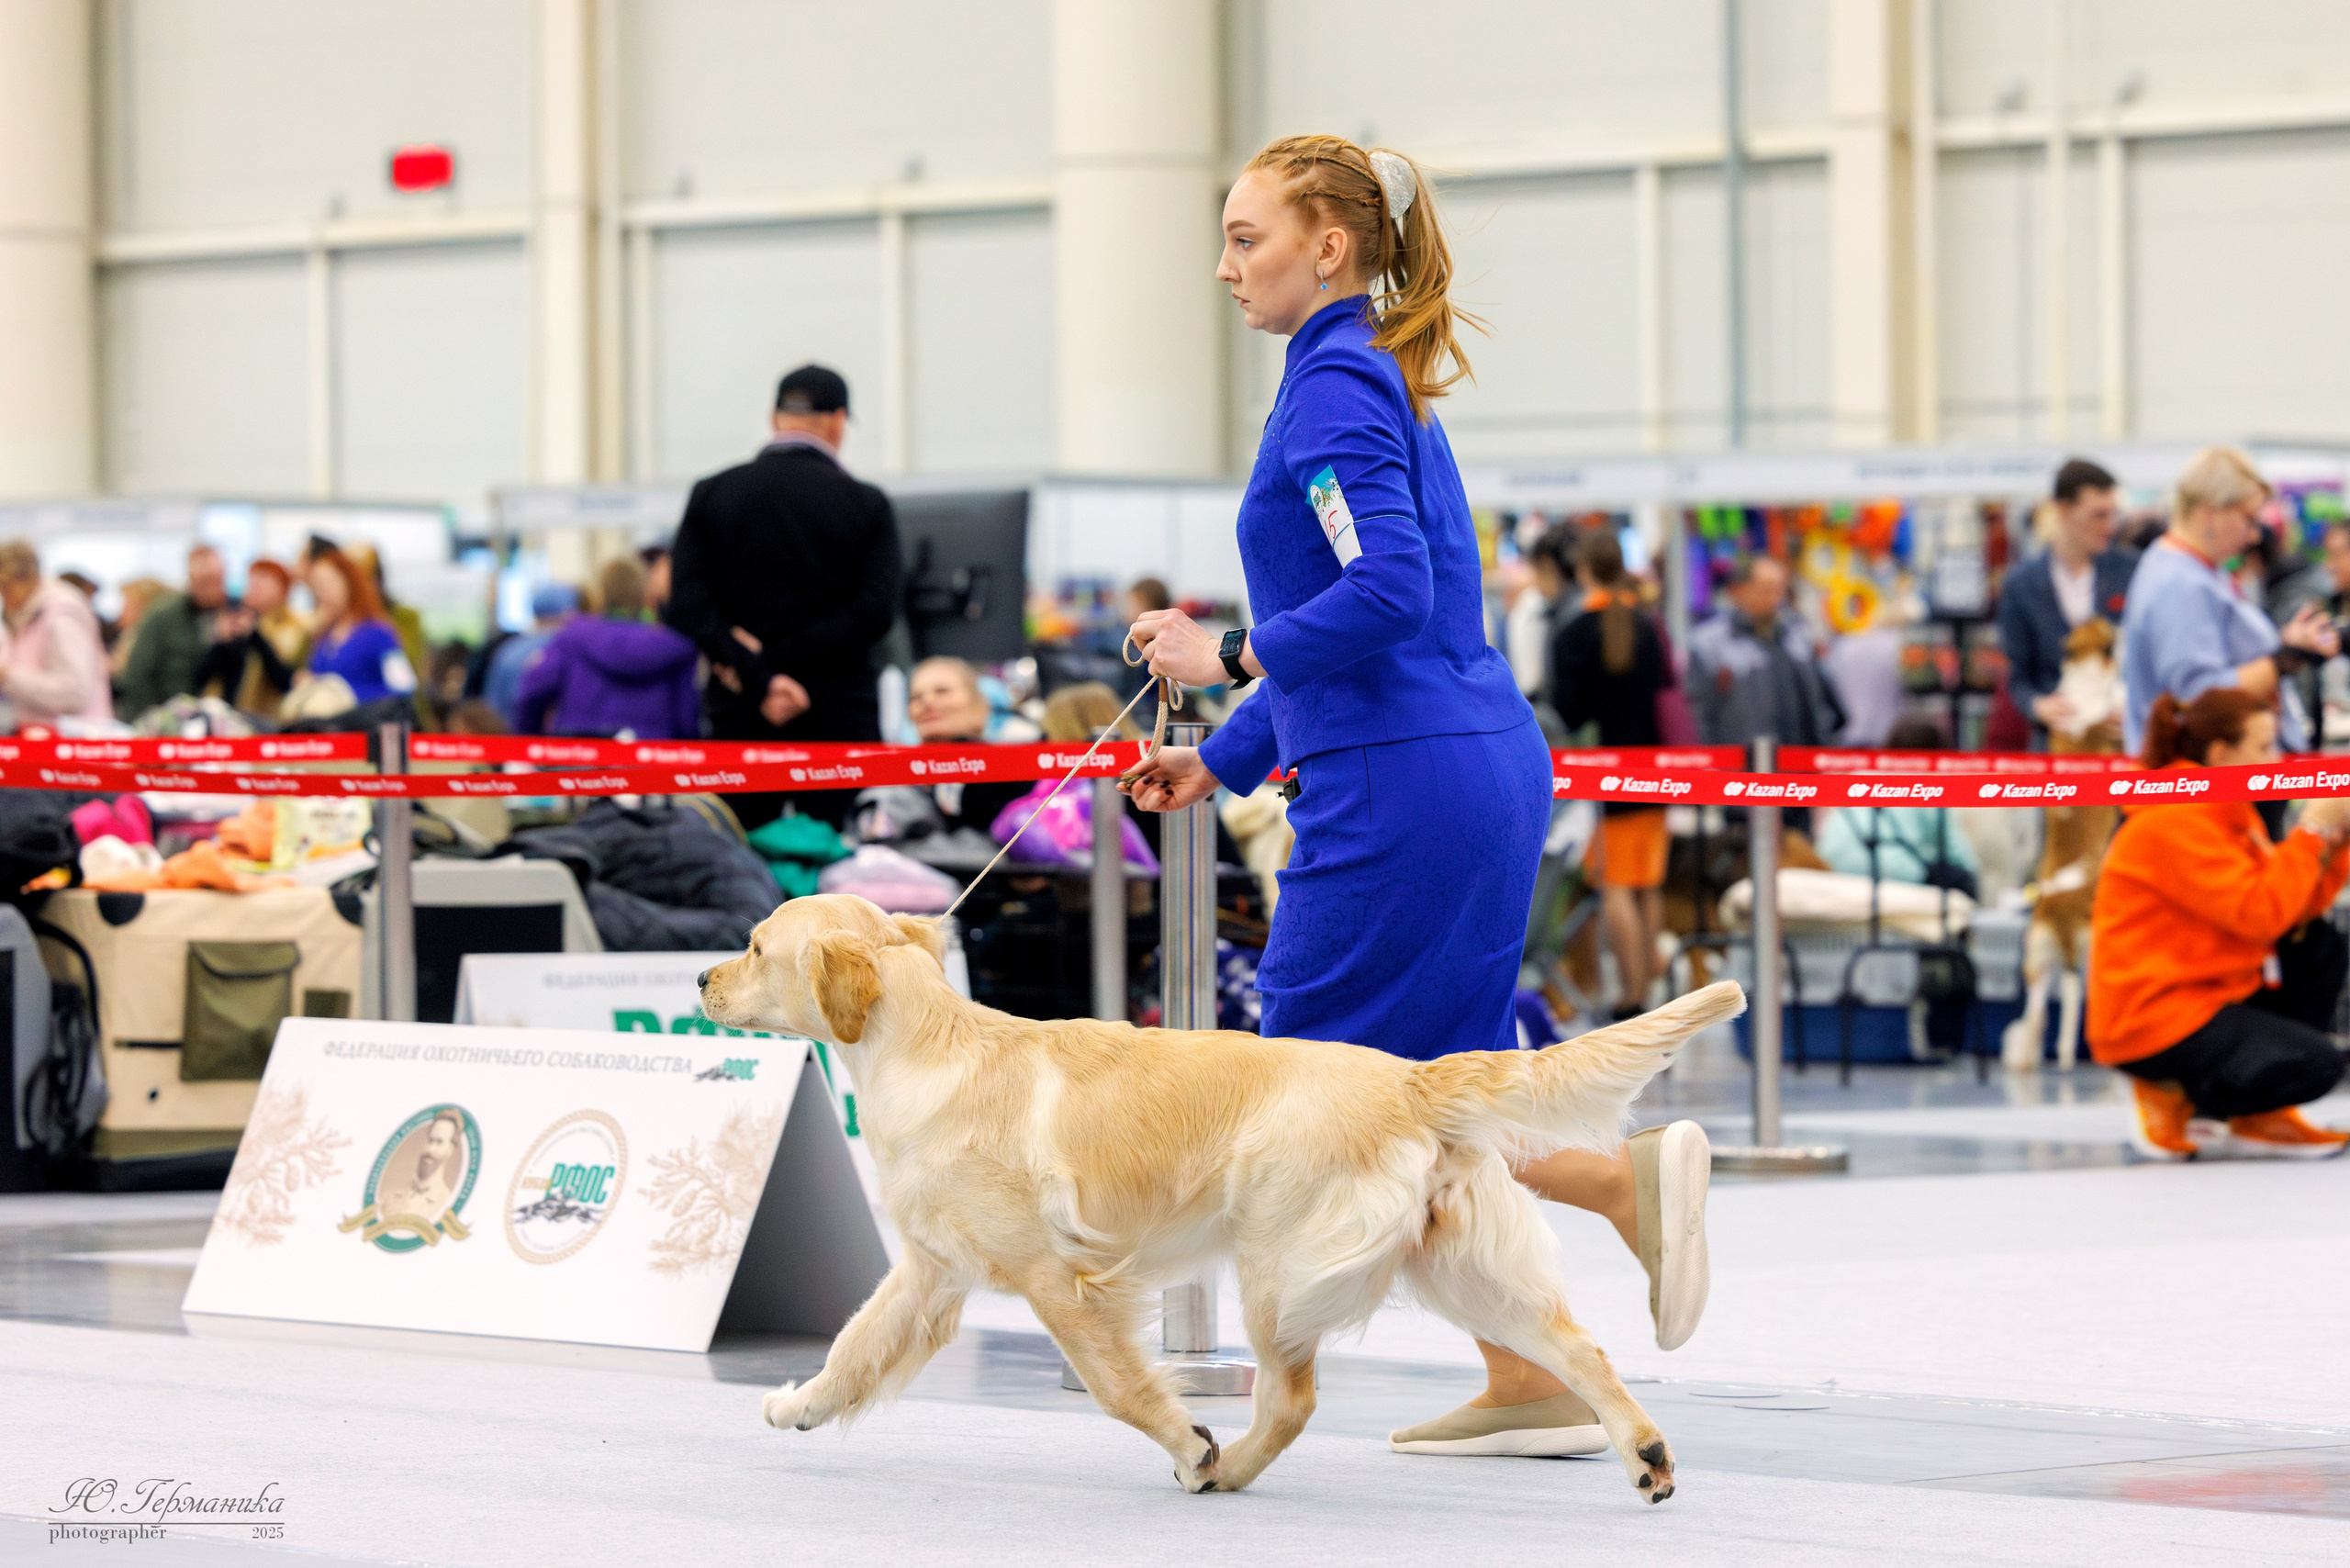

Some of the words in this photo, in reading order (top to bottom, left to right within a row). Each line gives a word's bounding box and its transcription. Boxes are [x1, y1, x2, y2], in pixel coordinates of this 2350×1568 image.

[928, 759, 959, 775] Kazan
[959, 757, 987, 776] Expo
[1087, 751, 1116, 769] Expo
[807, 767, 838, 781] Kazan
[836, 764, 864, 780] Expo
[2272, 773, 2314, 790] Kazan
[2315, 771, 2350, 790] Expo
[1621, 777, 1660, 793] Kazan
[1659, 778, 1692, 797] Expo
[1745, 782, 1785, 797] Kazan
[1784, 782, 1818, 801] Expo
[1869, 783, 1910, 798] Kazan
[1909, 783, 1944, 801] Expo
[2001, 784, 2042, 798] Kazan
[2042, 782, 2077, 801] Expo
[2132, 779, 2175, 795] Kazan
[2175, 778, 2210, 796] Expo
[323, 1039, 421, 1060] ФЕДЕРАЦИЯ
[422, 1045, 544, 1067] ОХОТНИЧЬЕГО
[547, 1050, 693, 1073] СОБАКОВОДСТВА
[545, 1162, 615, 1204] РФОС
